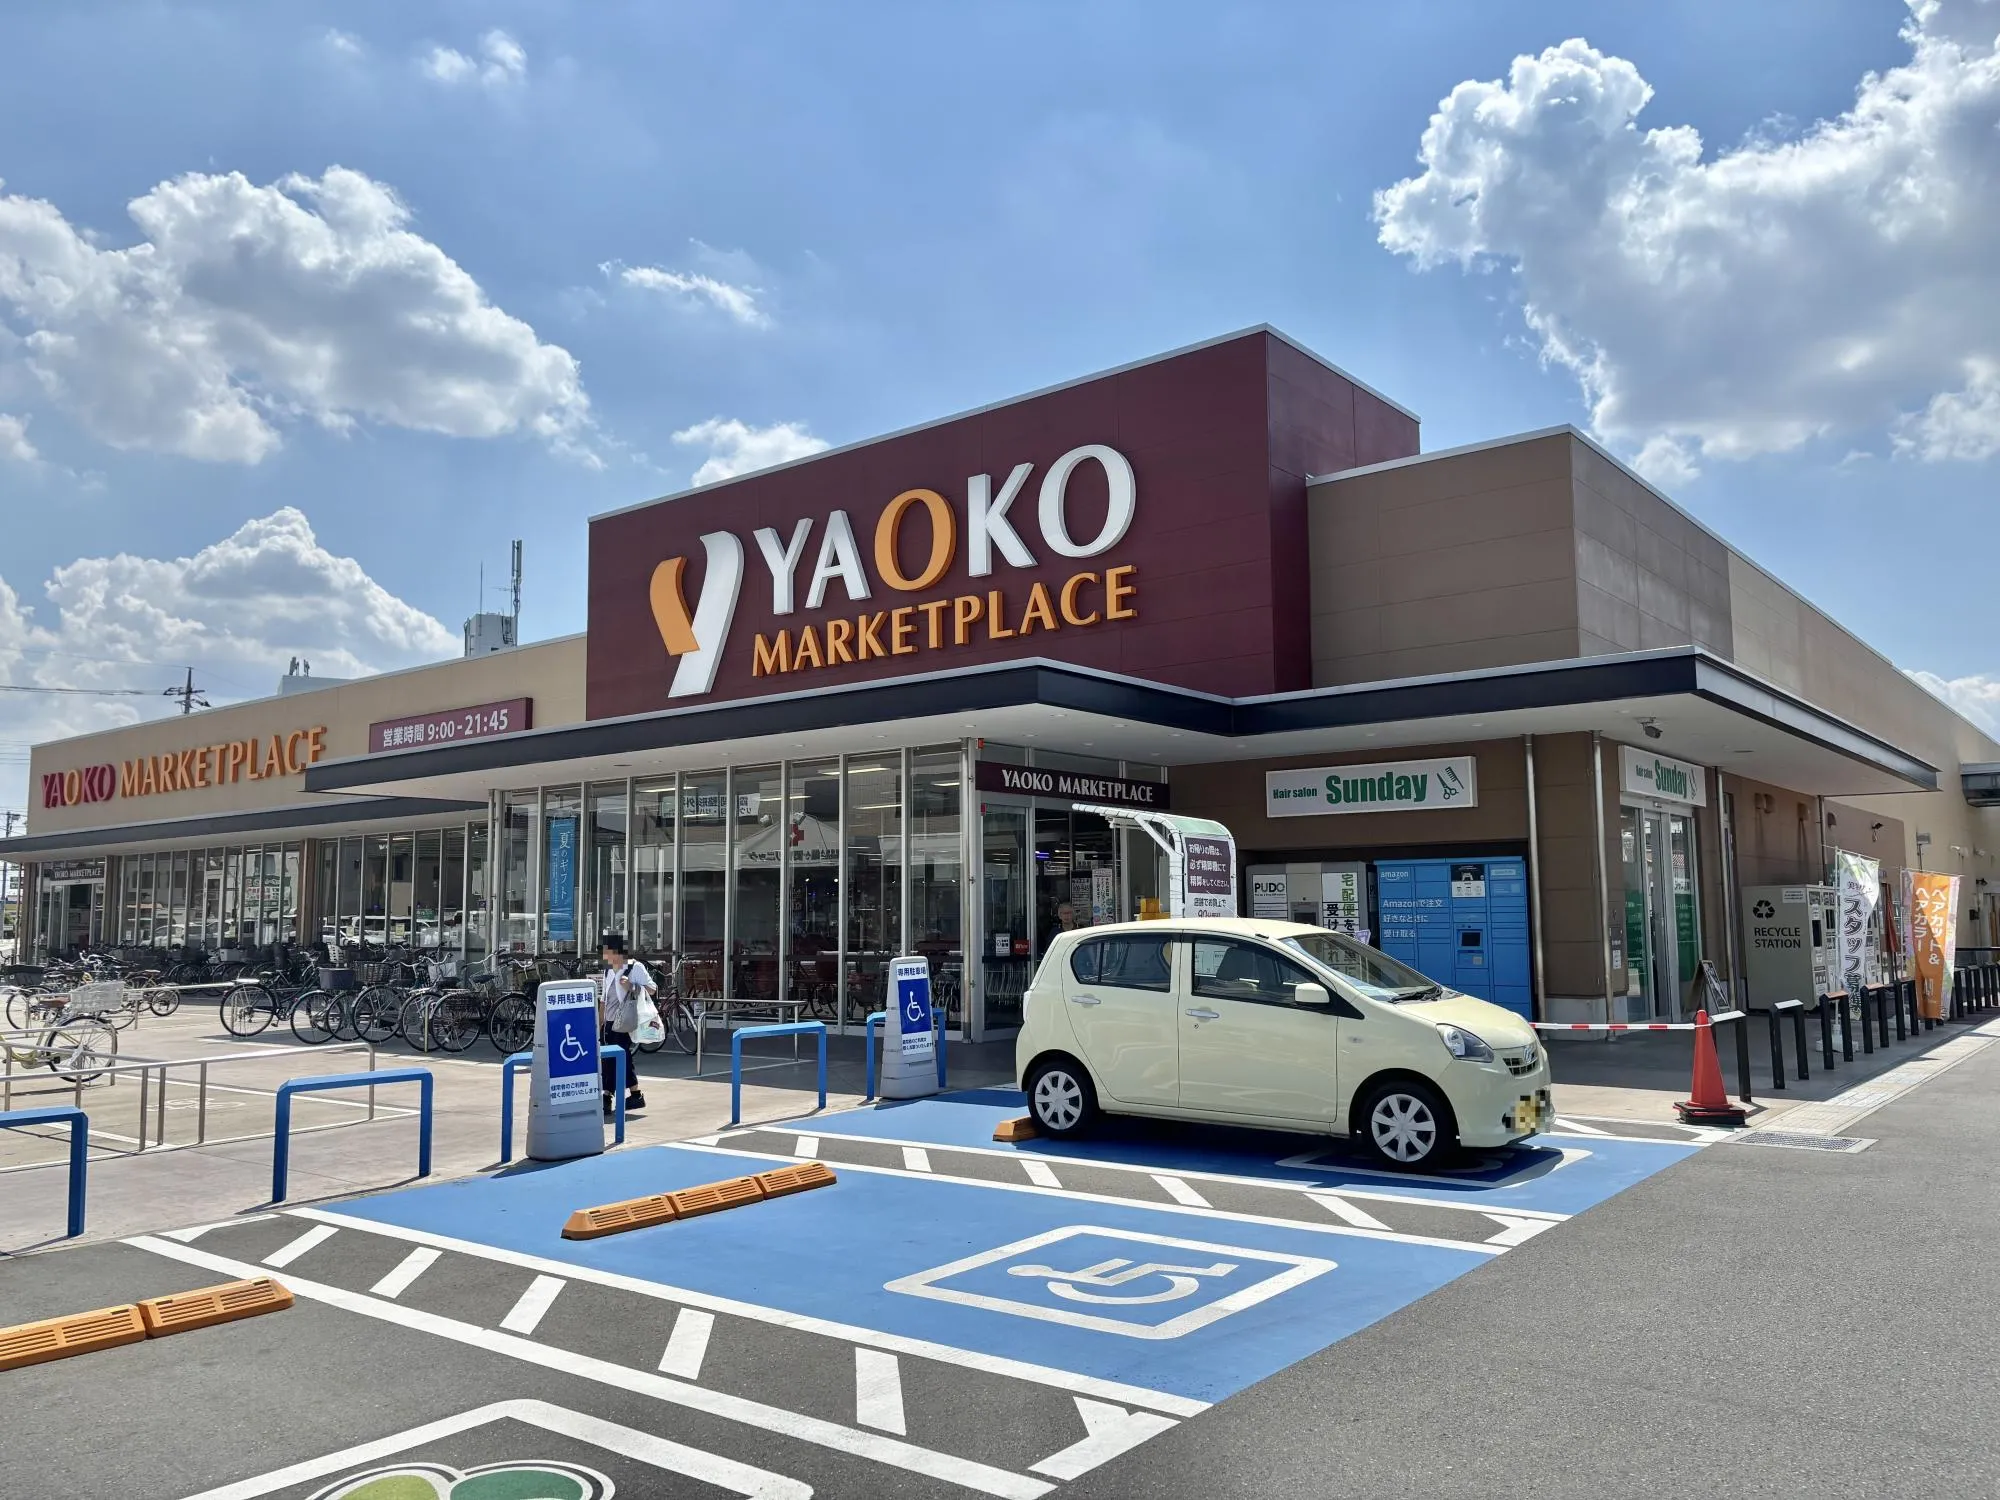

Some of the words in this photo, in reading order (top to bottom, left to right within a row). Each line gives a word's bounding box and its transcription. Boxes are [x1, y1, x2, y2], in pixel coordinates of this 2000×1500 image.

[753, 444, 1136, 616] YAOKO
[752, 564, 1137, 677] MARKETPLACE
[383, 723, 425, 748] 営業時間
[41, 764, 116, 808] YAOKO
[120, 726, 327, 798] MARKETPLACE
[1654, 759, 1687, 799] Sunday
[1001, 769, 1053, 792] YAOKO
[1058, 776, 1153, 802] MARKETPLACE
[1273, 787, 1291, 799] Hair
[1292, 786, 1318, 798] salon
[1325, 771, 1428, 805] Sunday
[559, 831, 571, 900] 夏のギフト
[1381, 870, 1409, 880] amazon
[1254, 882, 1286, 893] PUDO
[1383, 913, 1429, 923] 好きなときに
[1914, 887, 1930, 952] ヘアカラー
[1383, 929, 1417, 938] 受け取る
[1754, 927, 1801, 938] RECYCLE
[1754, 939, 1801, 949] STATION
[897, 966, 927, 977] 専用駐車場
[547, 991, 593, 1006] 専用駐車場
